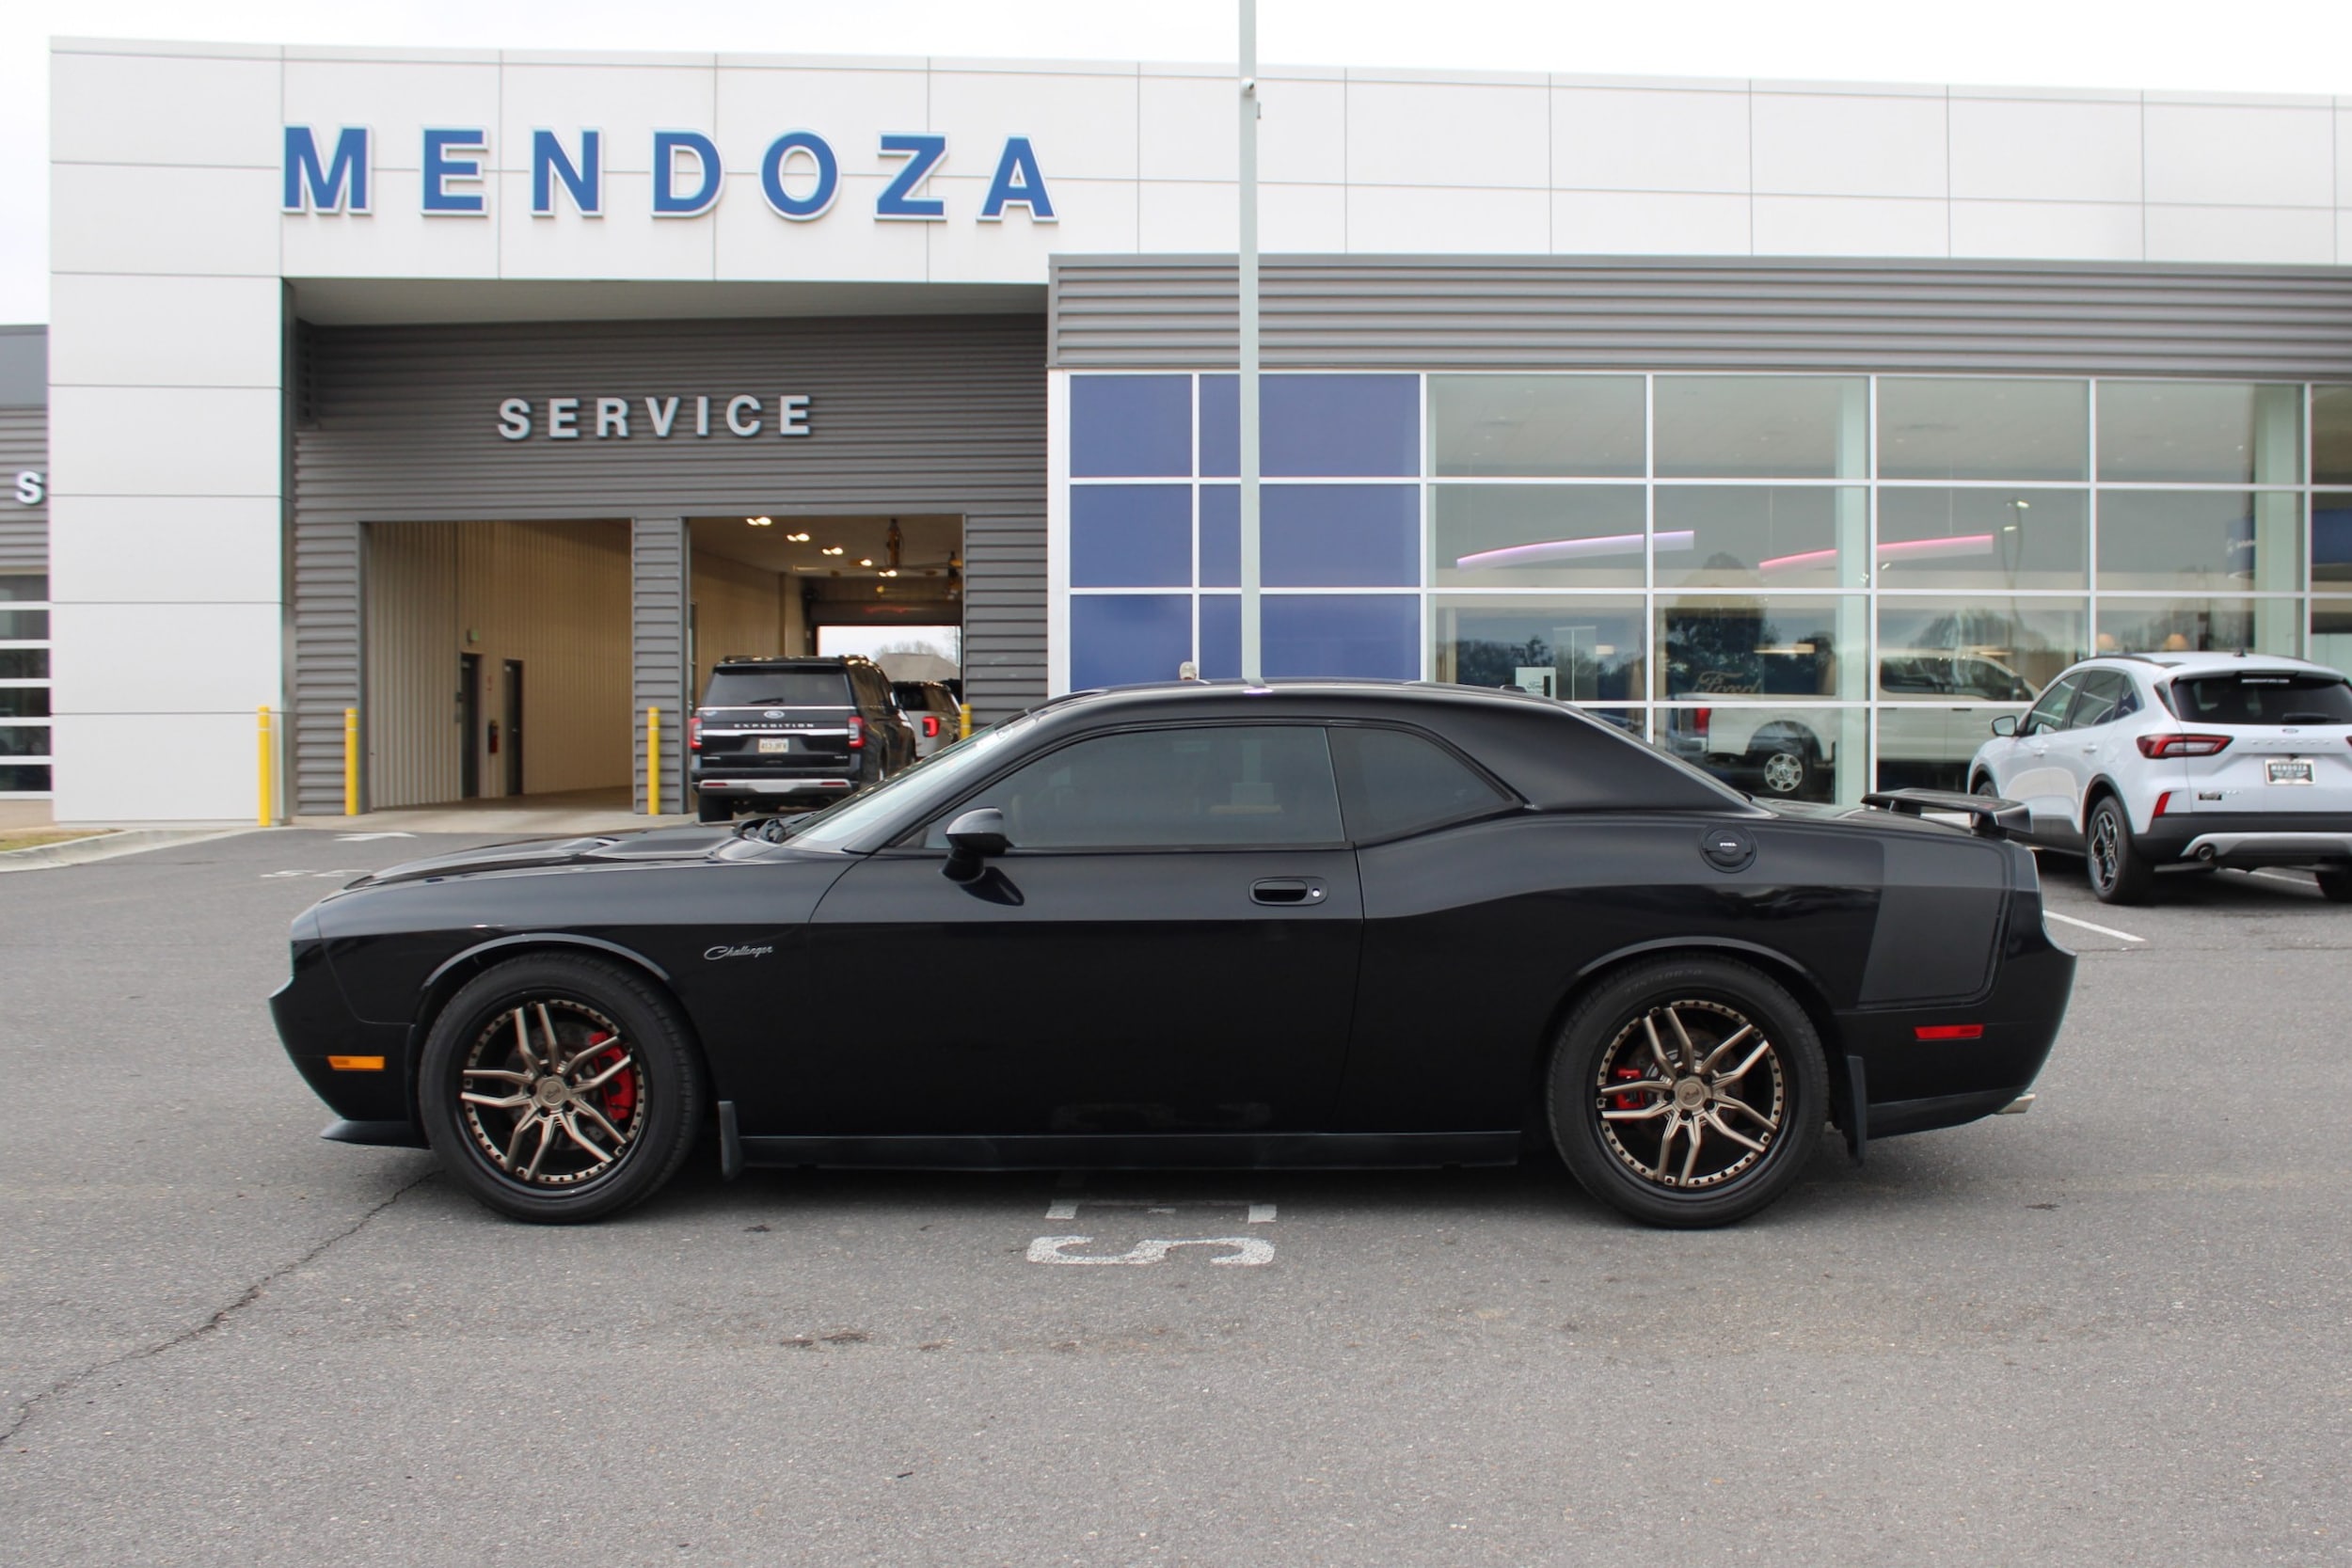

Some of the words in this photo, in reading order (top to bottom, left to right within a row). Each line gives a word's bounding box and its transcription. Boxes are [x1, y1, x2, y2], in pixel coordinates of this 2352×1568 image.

[282, 124, 1058, 222] MENDOZA
[498, 394, 810, 439] SERVICE
[704, 945, 773, 960] Challenger
